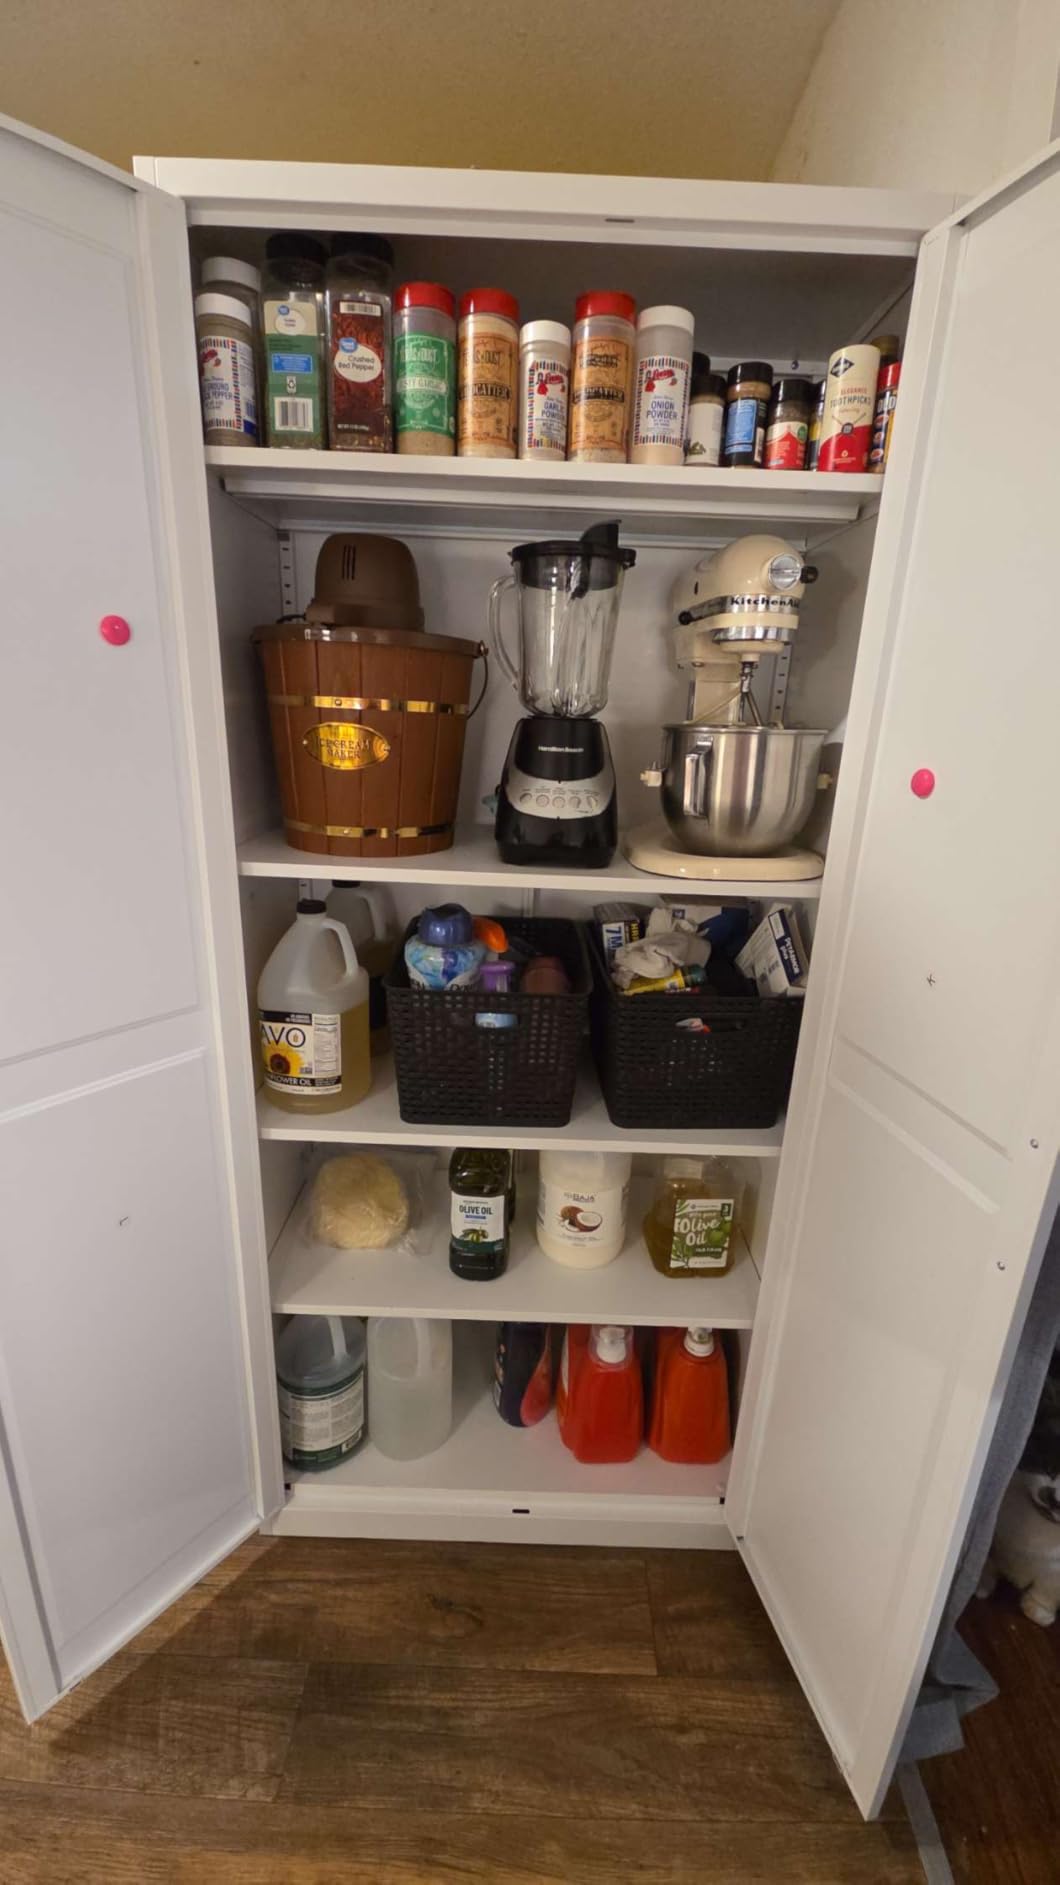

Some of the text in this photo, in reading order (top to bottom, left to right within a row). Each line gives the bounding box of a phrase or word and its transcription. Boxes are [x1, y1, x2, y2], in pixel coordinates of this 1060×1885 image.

[651, 400, 675, 410] ONION
[646, 410, 678, 420] POWDER
[458, 1204, 493, 1215] OLIVE OIL
[680, 1217, 721, 1234] Olive
[685, 1231, 706, 1246] Oil
